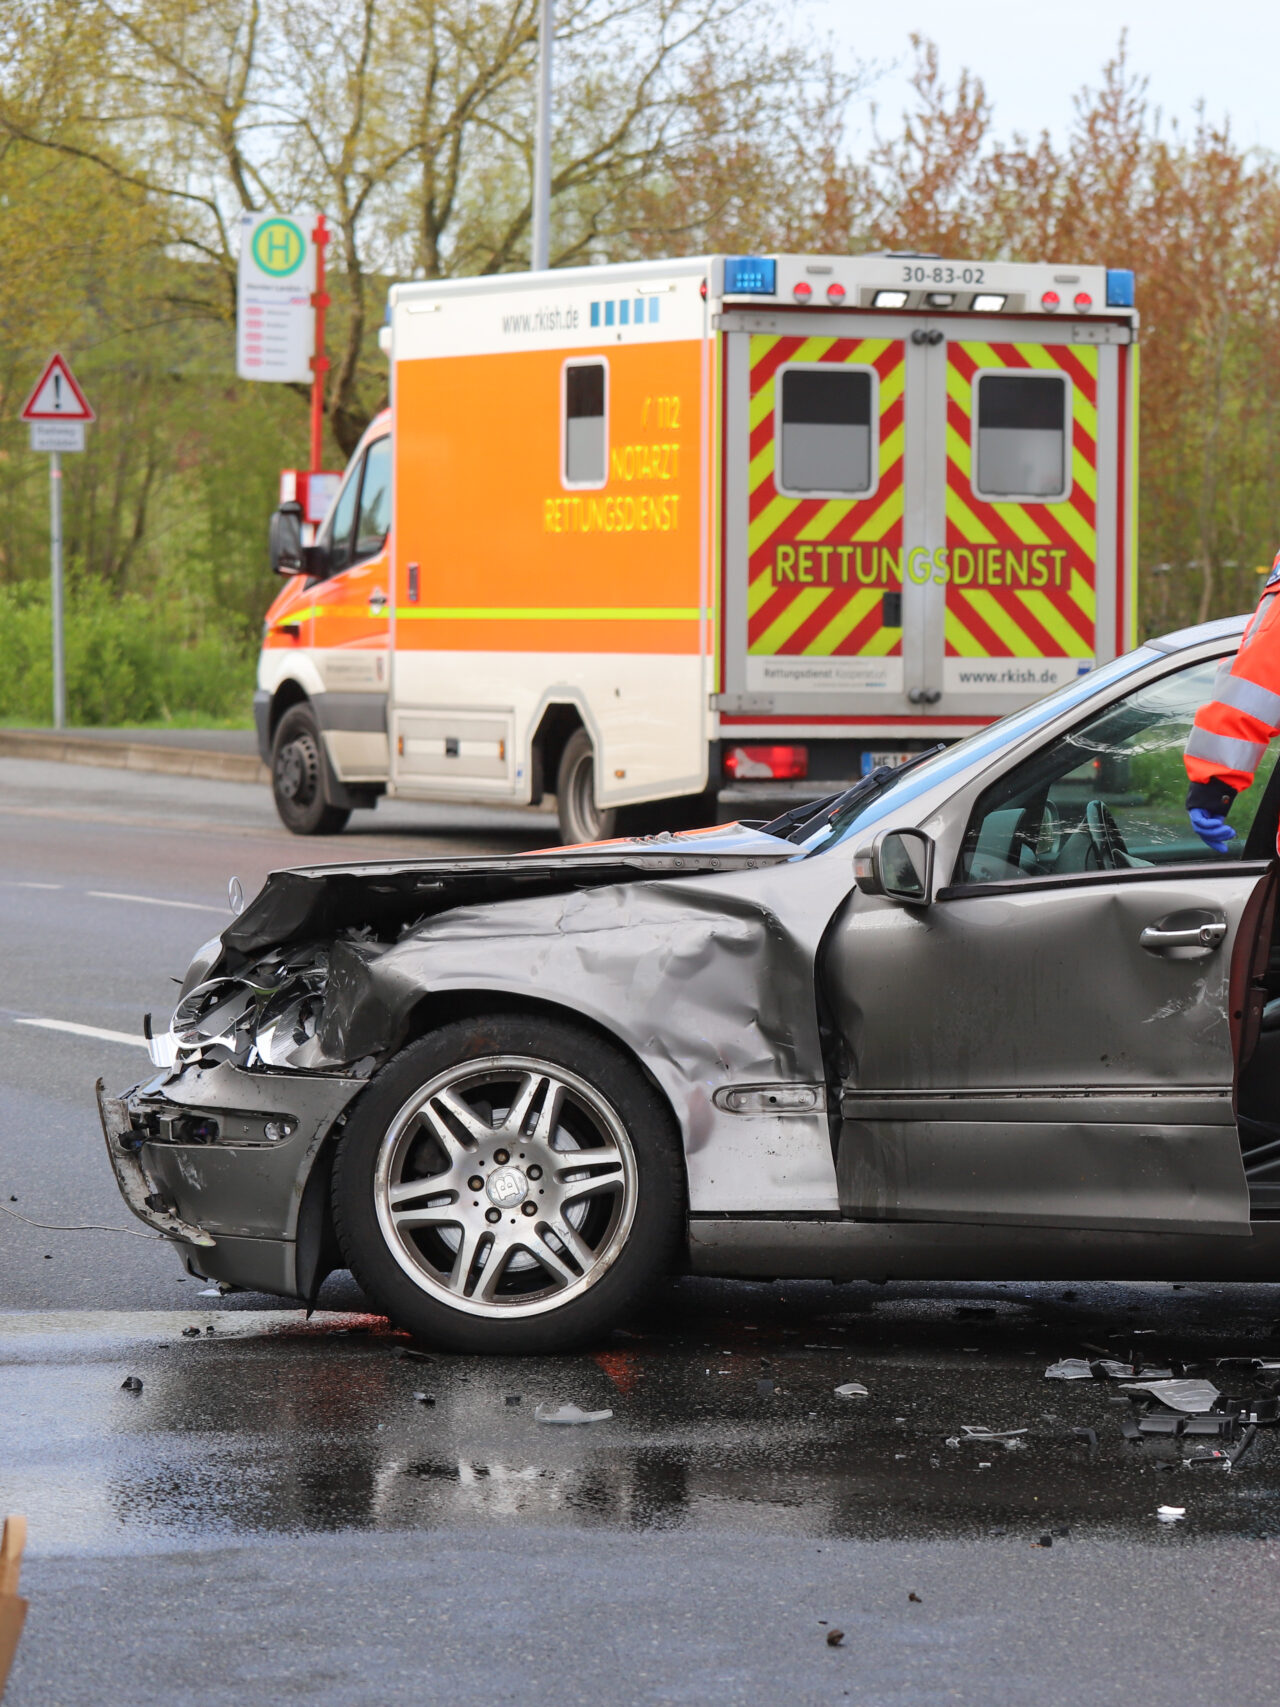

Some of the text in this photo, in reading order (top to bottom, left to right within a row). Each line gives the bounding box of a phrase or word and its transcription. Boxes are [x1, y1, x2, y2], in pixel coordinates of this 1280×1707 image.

[902, 266, 985, 285] 30-83-02
[503, 307, 579, 333] www.rkish.de
[609, 444, 681, 481] NOTARZT
[543, 495, 681, 533] RETTUNGSDIENST
[776, 545, 1067, 586] RETTUNGSDIENST
[959, 670, 1058, 684] www.rkish.de
